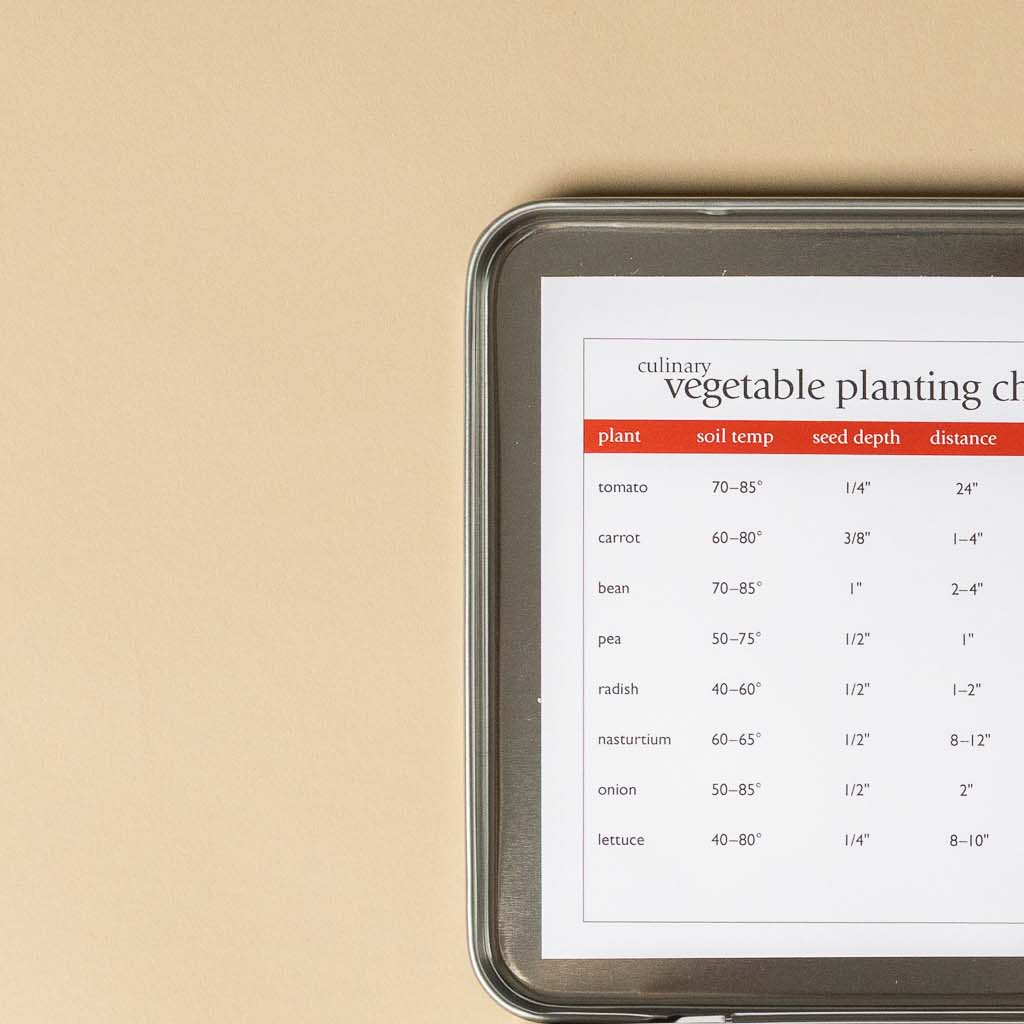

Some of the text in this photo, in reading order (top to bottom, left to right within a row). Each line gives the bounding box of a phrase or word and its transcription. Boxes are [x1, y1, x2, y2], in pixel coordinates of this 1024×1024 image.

[637, 356, 713, 377] culinary
[663, 368, 826, 409] vegetable
[834, 370, 983, 411] planting
[598, 426, 641, 447] plant
[696, 427, 727, 444] soil
[731, 430, 774, 448] temp
[812, 428, 849, 445] seed
[853, 428, 901, 449] depth
[929, 429, 998, 446] distance
[598, 483, 648, 493] tomato
[598, 533, 641, 544] carrot
[598, 581, 630, 594] bean
[598, 635, 622, 648] pea
[598, 682, 639, 695] radish
[598, 733, 671, 746] nasturtium
[597, 783, 637, 796] onion
[598, 833, 645, 846] lettuce
